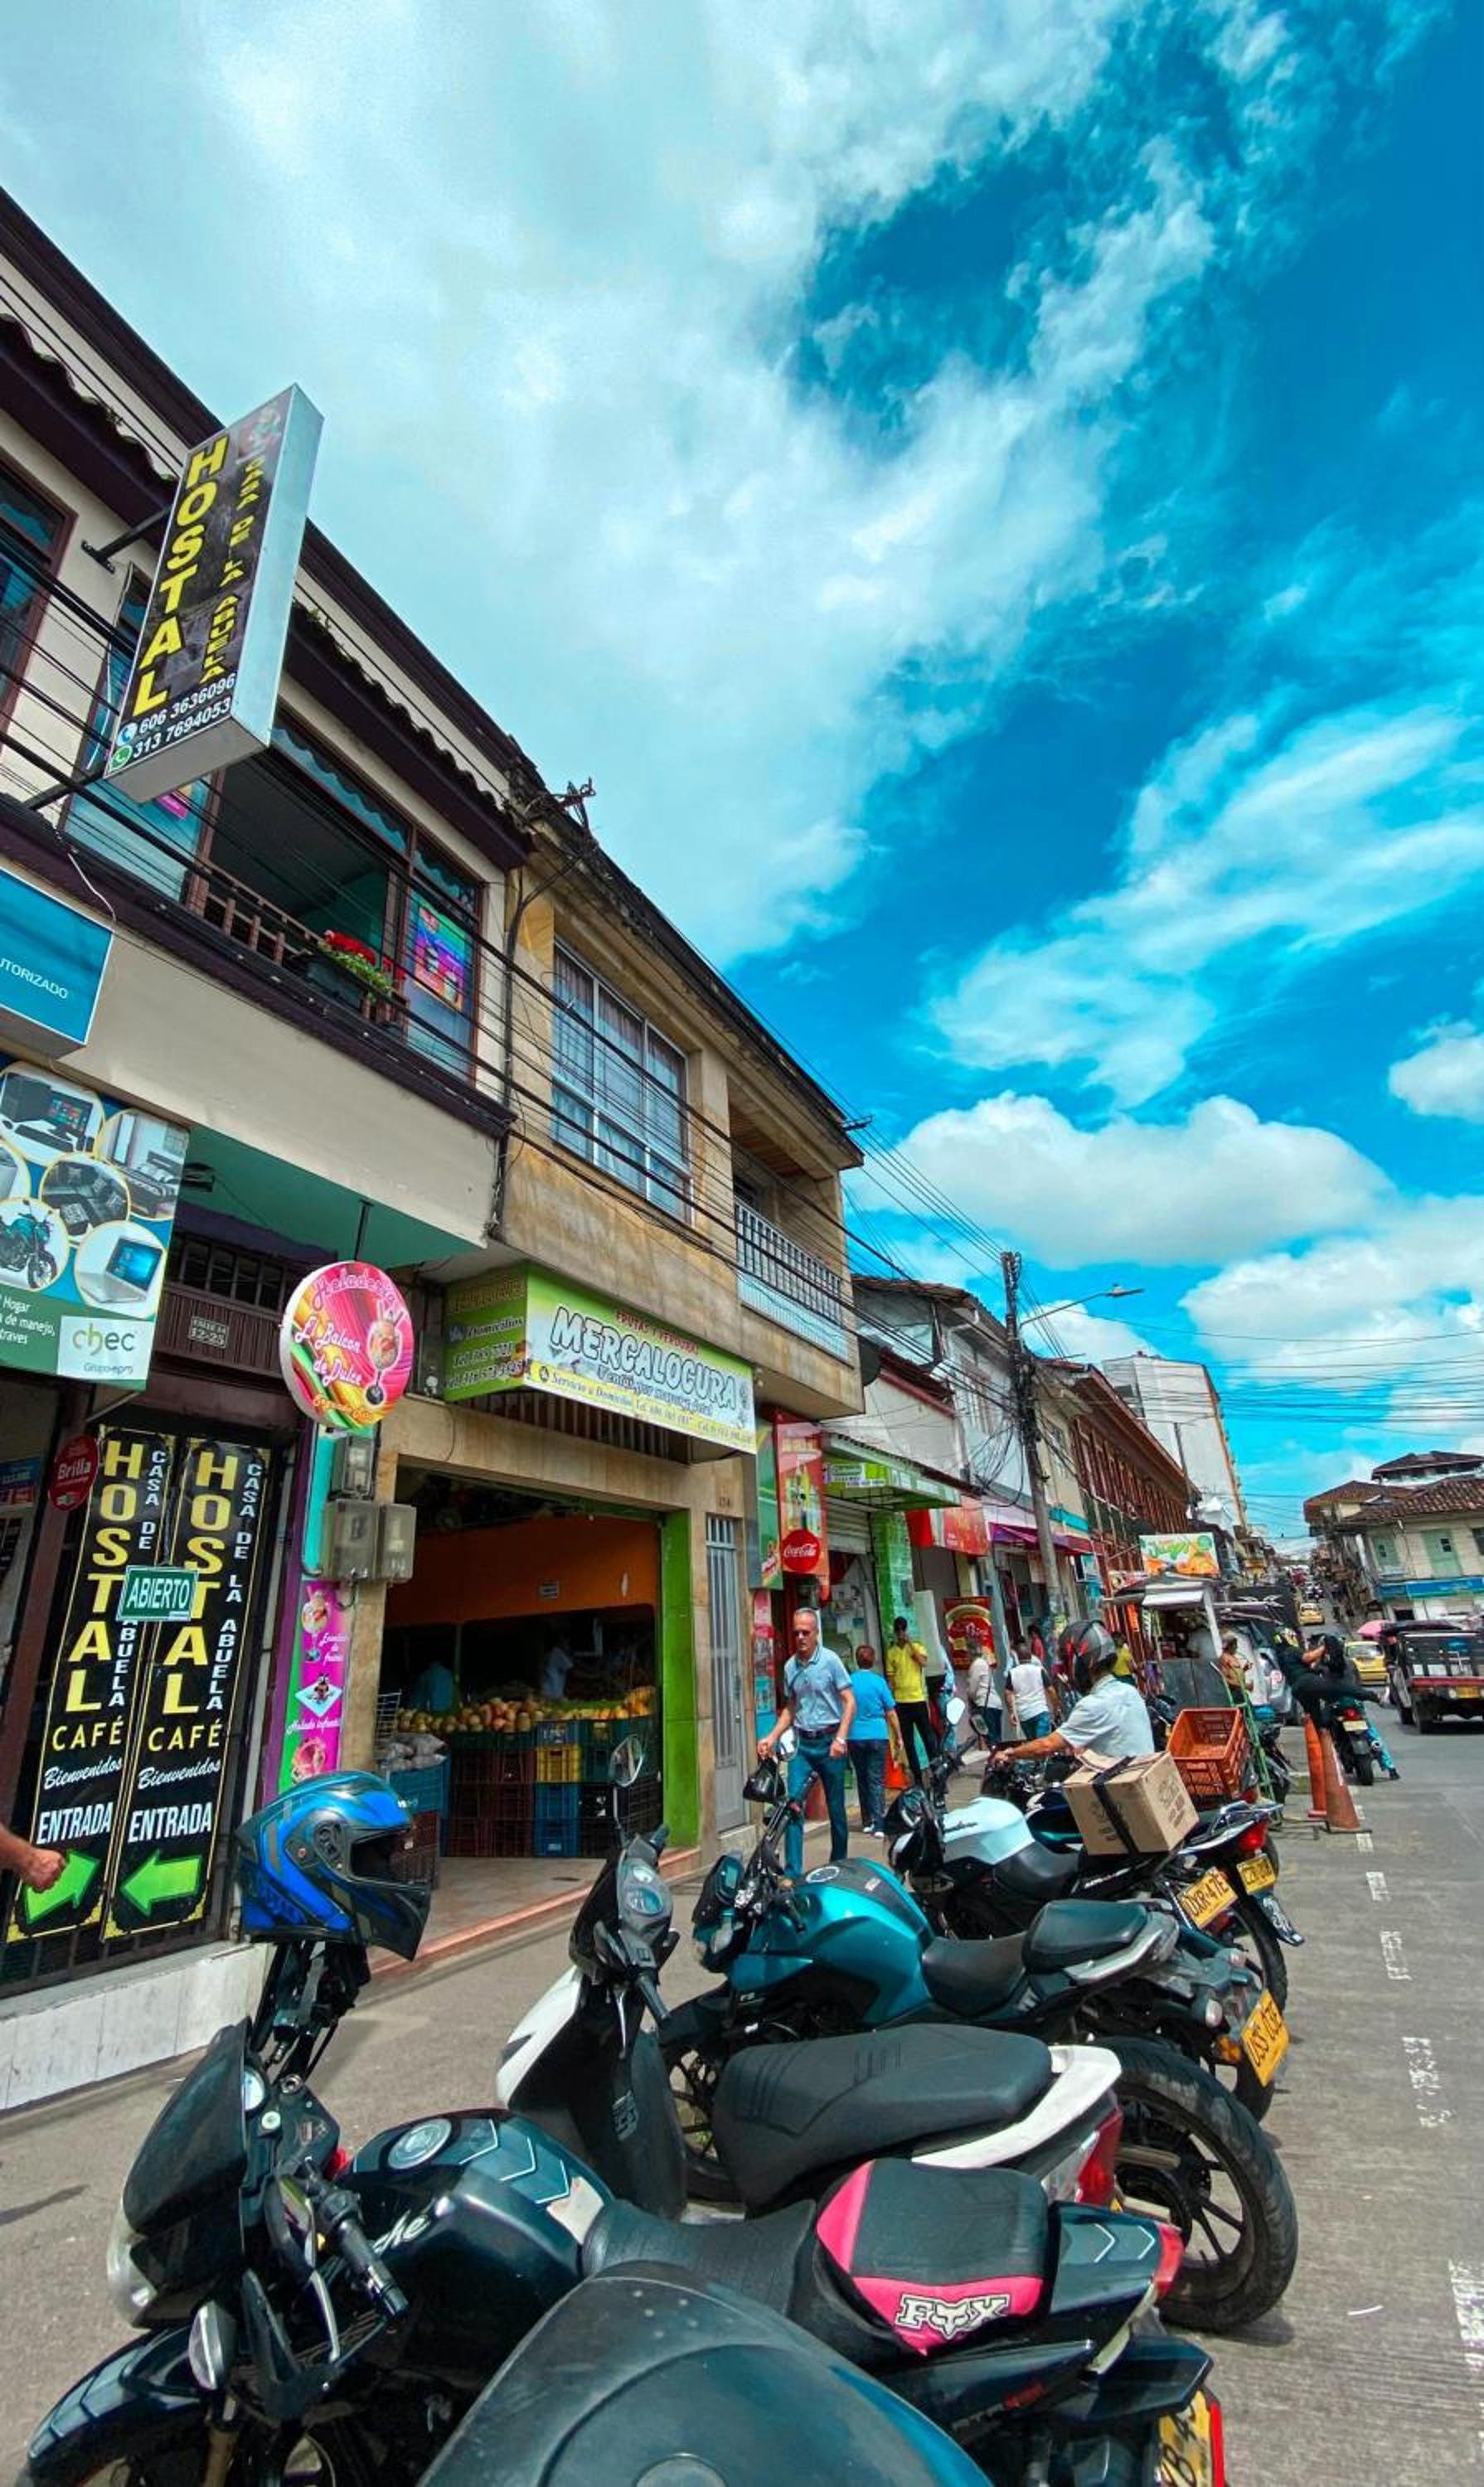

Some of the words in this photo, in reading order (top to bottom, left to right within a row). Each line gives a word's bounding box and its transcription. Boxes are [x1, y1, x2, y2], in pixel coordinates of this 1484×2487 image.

[236, 455, 265, 512] CASA
[230, 516, 252, 548] DE
[132, 435, 229, 719] HOSTAL
[219, 560, 245, 589] LA
[199, 594, 241, 685] ABUELA
[138, 711, 168, 735] 606
[171, 674, 236, 721] 3636096
[132, 735, 162, 759] 313
[165, 696, 232, 744] 7694053
[72, 1323, 135, 1355] chec
[550, 1306, 737, 1411] MERCALOCURA
[57, 1459, 92, 1481] Brilla
[145, 1451, 167, 1506] CASA
[240, 1464, 263, 1517] CASA
[138, 1521, 155, 1549] DE
[234, 1532, 252, 1559] DE
[65, 1440, 143, 1712] HOSTAL
[126, 1578, 190, 1609] ABIERTO
[162, 1452, 239, 1714] HOSTAL
[226, 1575, 242, 1602] LA
[206, 1619, 237, 1710] ABUELA
[52, 1715, 124, 1751] CAFÉ
[148, 1719, 222, 1752] CAFÉ
[44, 1757, 123, 1790] Bienvenidos
[138, 1757, 221, 1790] Bienvenidos
[36, 1802, 114, 1845] ENTRADA
[128, 1802, 213, 1844] ENTRADA
